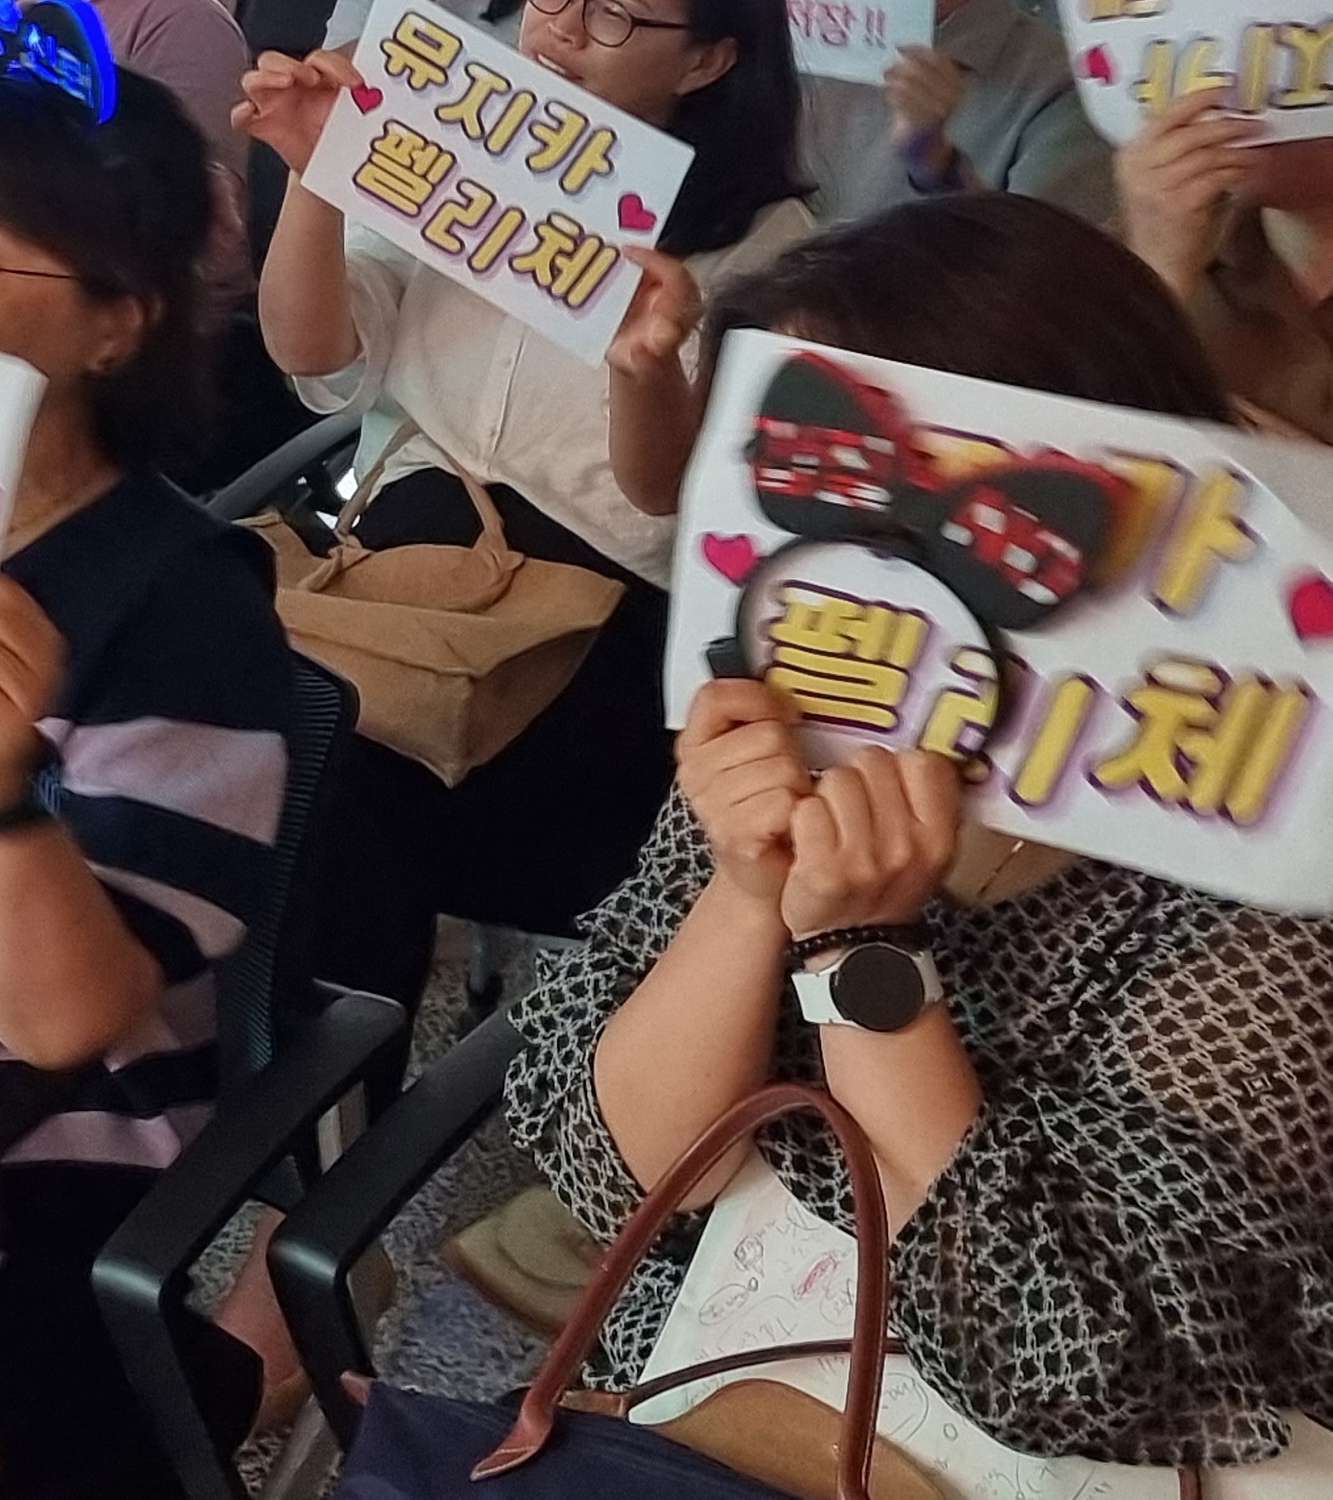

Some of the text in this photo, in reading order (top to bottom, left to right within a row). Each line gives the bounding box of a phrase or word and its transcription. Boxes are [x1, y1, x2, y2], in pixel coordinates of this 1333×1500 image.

[379, 11, 618, 195] 뮤지카
[352, 118, 621, 309] 펠리체
[765, 578, 1317, 828] 펠리체
